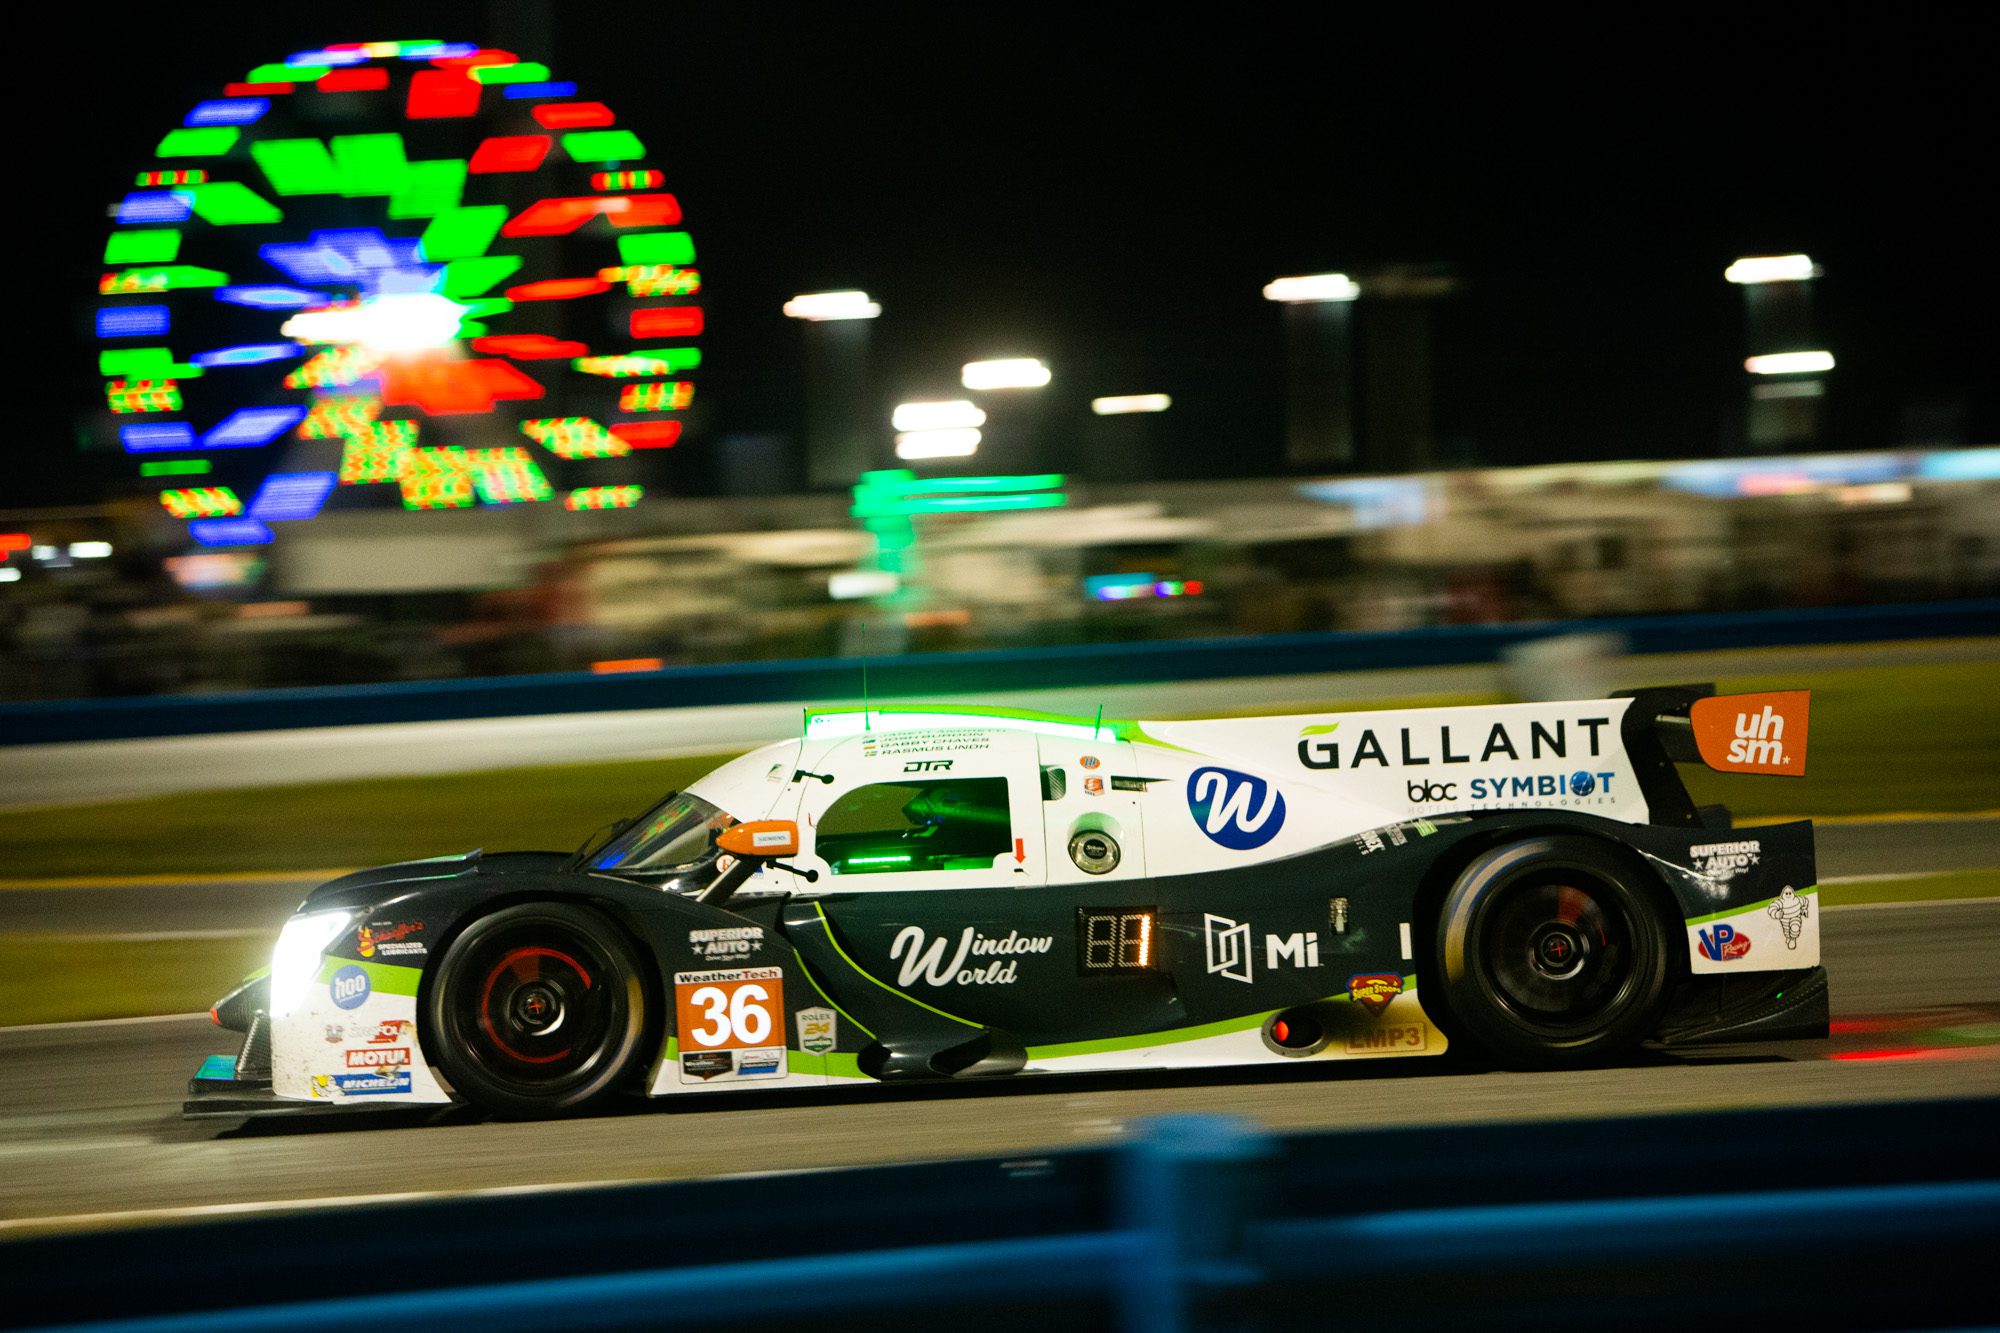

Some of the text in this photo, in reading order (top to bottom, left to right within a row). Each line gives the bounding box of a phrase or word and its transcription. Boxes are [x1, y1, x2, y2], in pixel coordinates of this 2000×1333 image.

[1735, 705, 1784, 739] uh
[882, 745, 944, 755] RASMUS
[1298, 718, 1610, 770] GALLANT
[903, 760, 954, 772] DTR
[1407, 779, 1457, 803] bloc
[1470, 797, 1616, 811] TECHNOLOGIES
[1690, 840, 1760, 858] SUPERIOR
[1704, 853, 1749, 870] AUTO
[689, 926, 764, 943] SUPERIOR
[1698, 923, 1735, 961] VP
[703, 939, 750, 955] AUTO
[679, 969, 777, 983] WeatherTech
[690, 984, 772, 1047] 36
[801, 1013, 832, 1021] ROLEX
[804, 1022, 831, 1035] 24
[1349, 1027, 1420, 1049] LMP3
